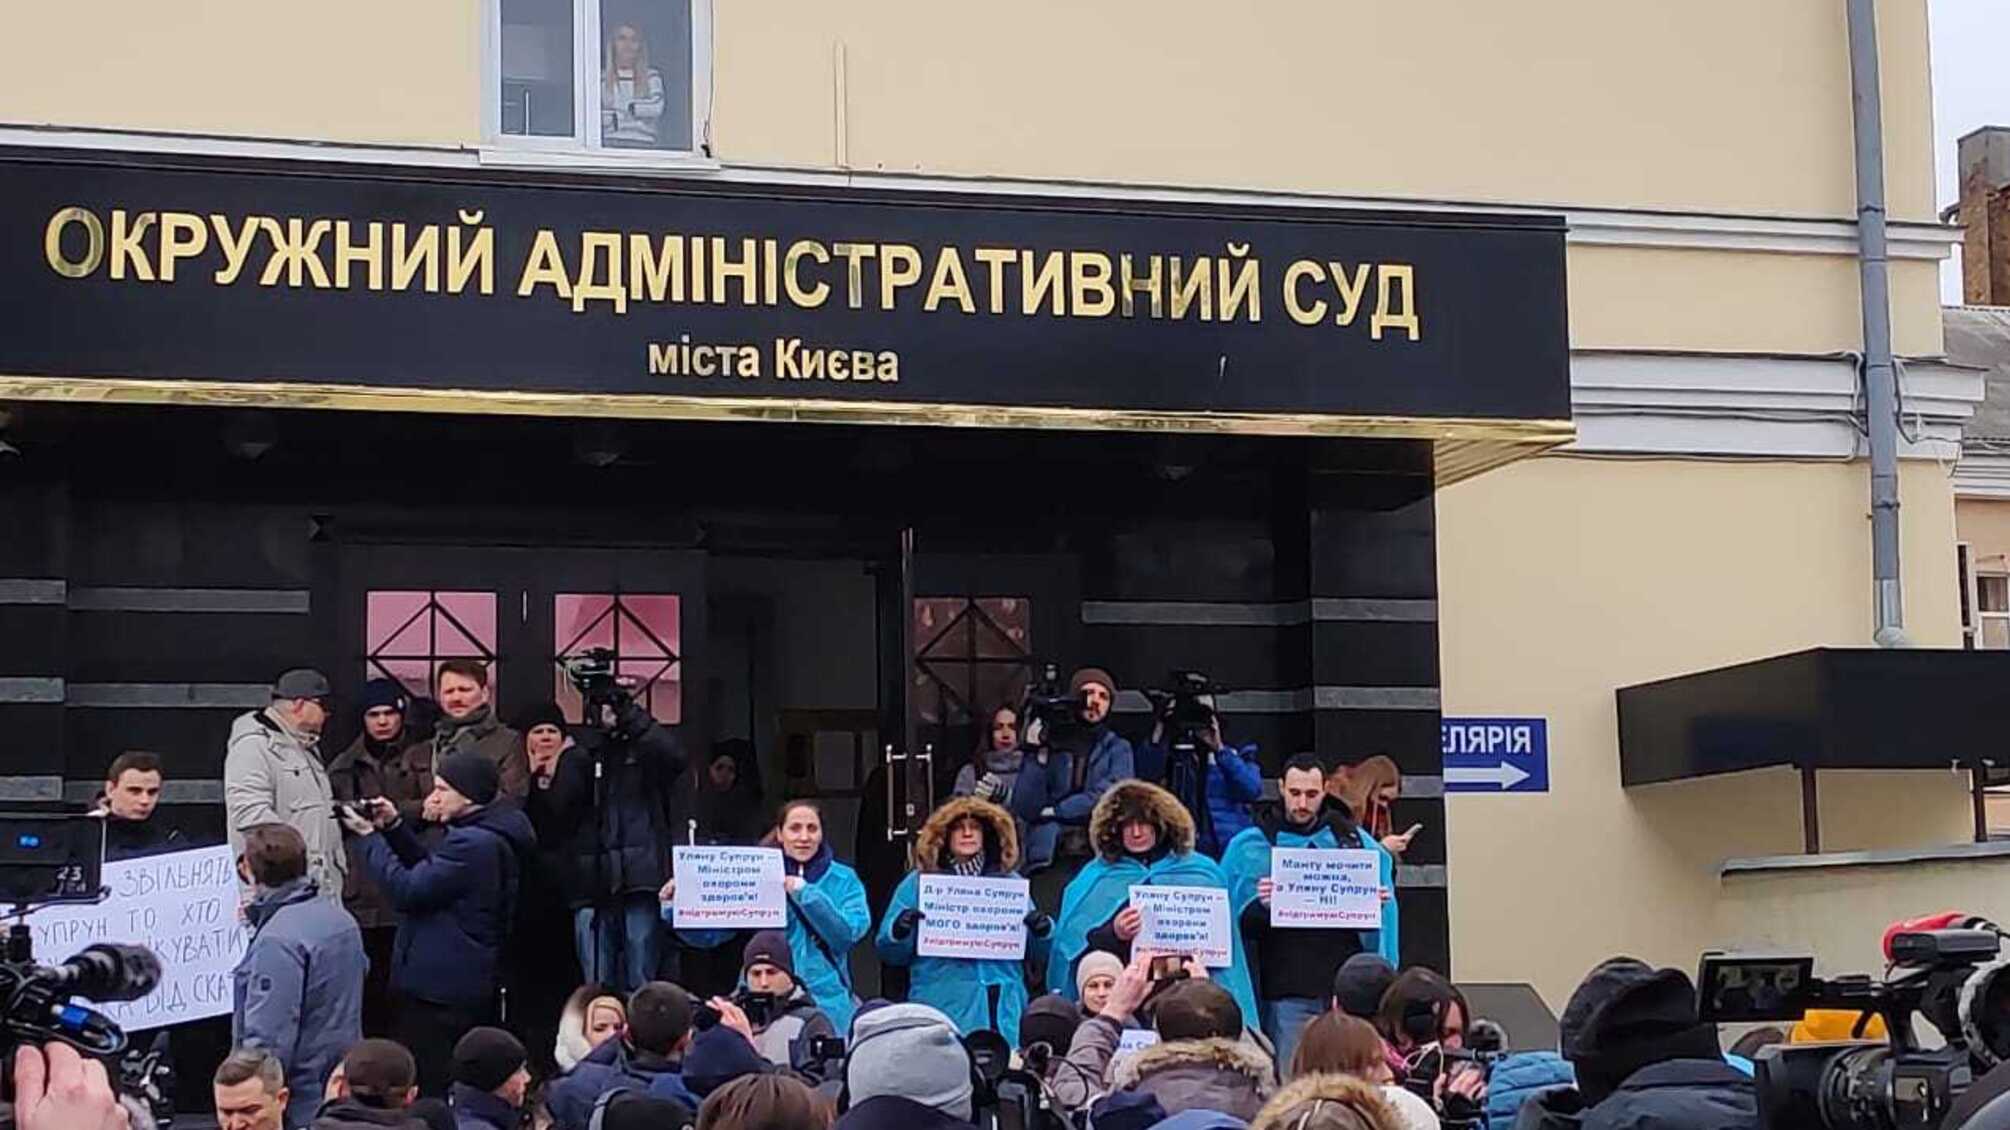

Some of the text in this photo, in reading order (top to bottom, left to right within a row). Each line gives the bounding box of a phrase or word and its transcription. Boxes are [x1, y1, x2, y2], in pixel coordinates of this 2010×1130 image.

[44, 206, 1420, 340] ОКРУЖНИЙ АДМІНІСТРАТИВНИЙ СУД
[648, 334, 900, 383] міста Києва
[39, 898, 221, 946] УПРУН ТО ХТО
[925, 919, 960, 930] МОГО
